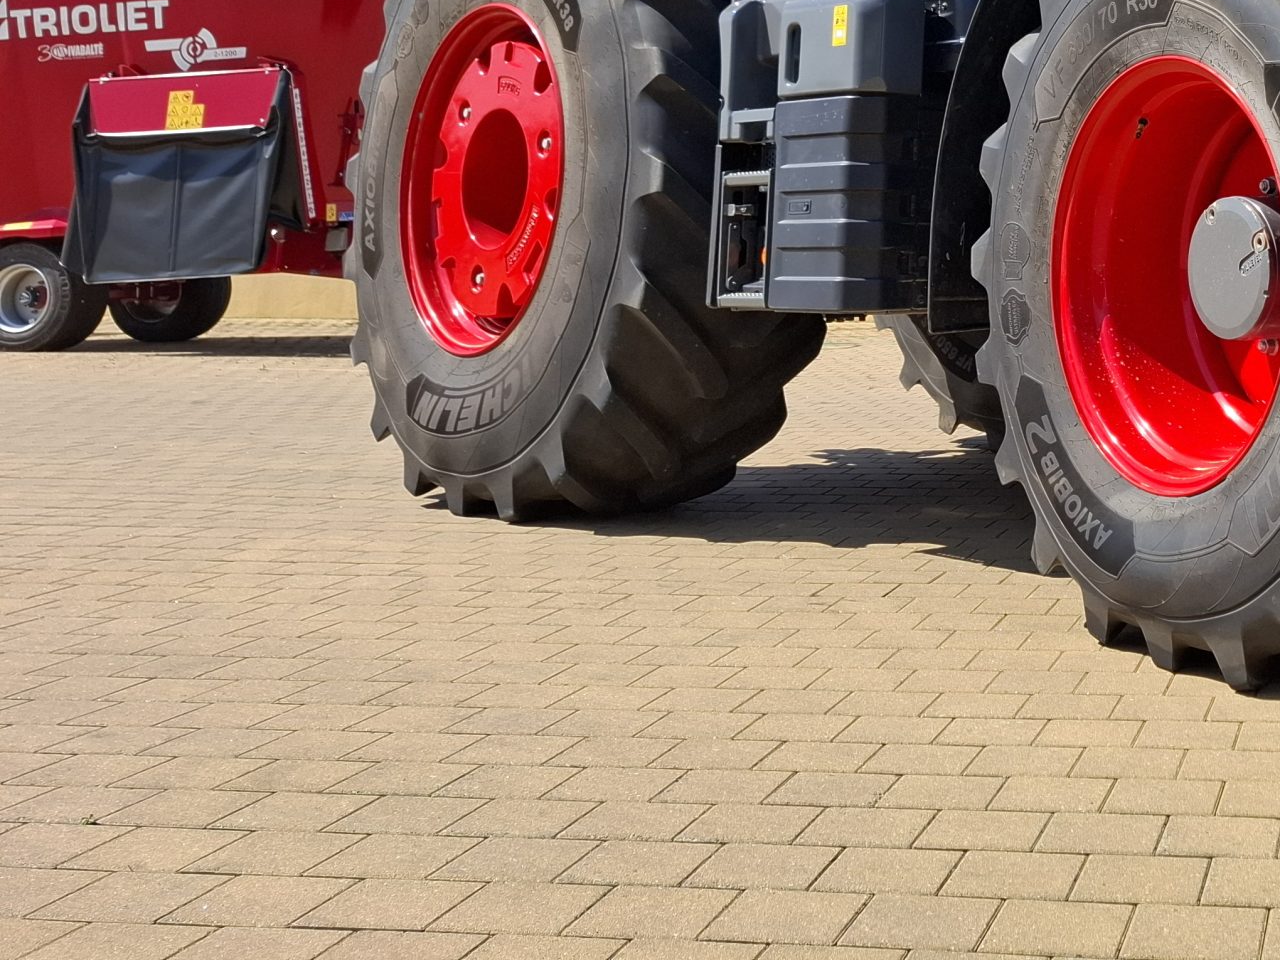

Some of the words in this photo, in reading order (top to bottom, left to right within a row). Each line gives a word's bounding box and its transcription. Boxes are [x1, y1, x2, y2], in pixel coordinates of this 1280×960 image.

[10, 0, 169, 39] TRIOLIET
[1043, 58, 1064, 99] VF
[413, 343, 538, 432] ICHELIN
[1025, 414, 1057, 455] 2
[1040, 451, 1113, 550] AXIOBIB
